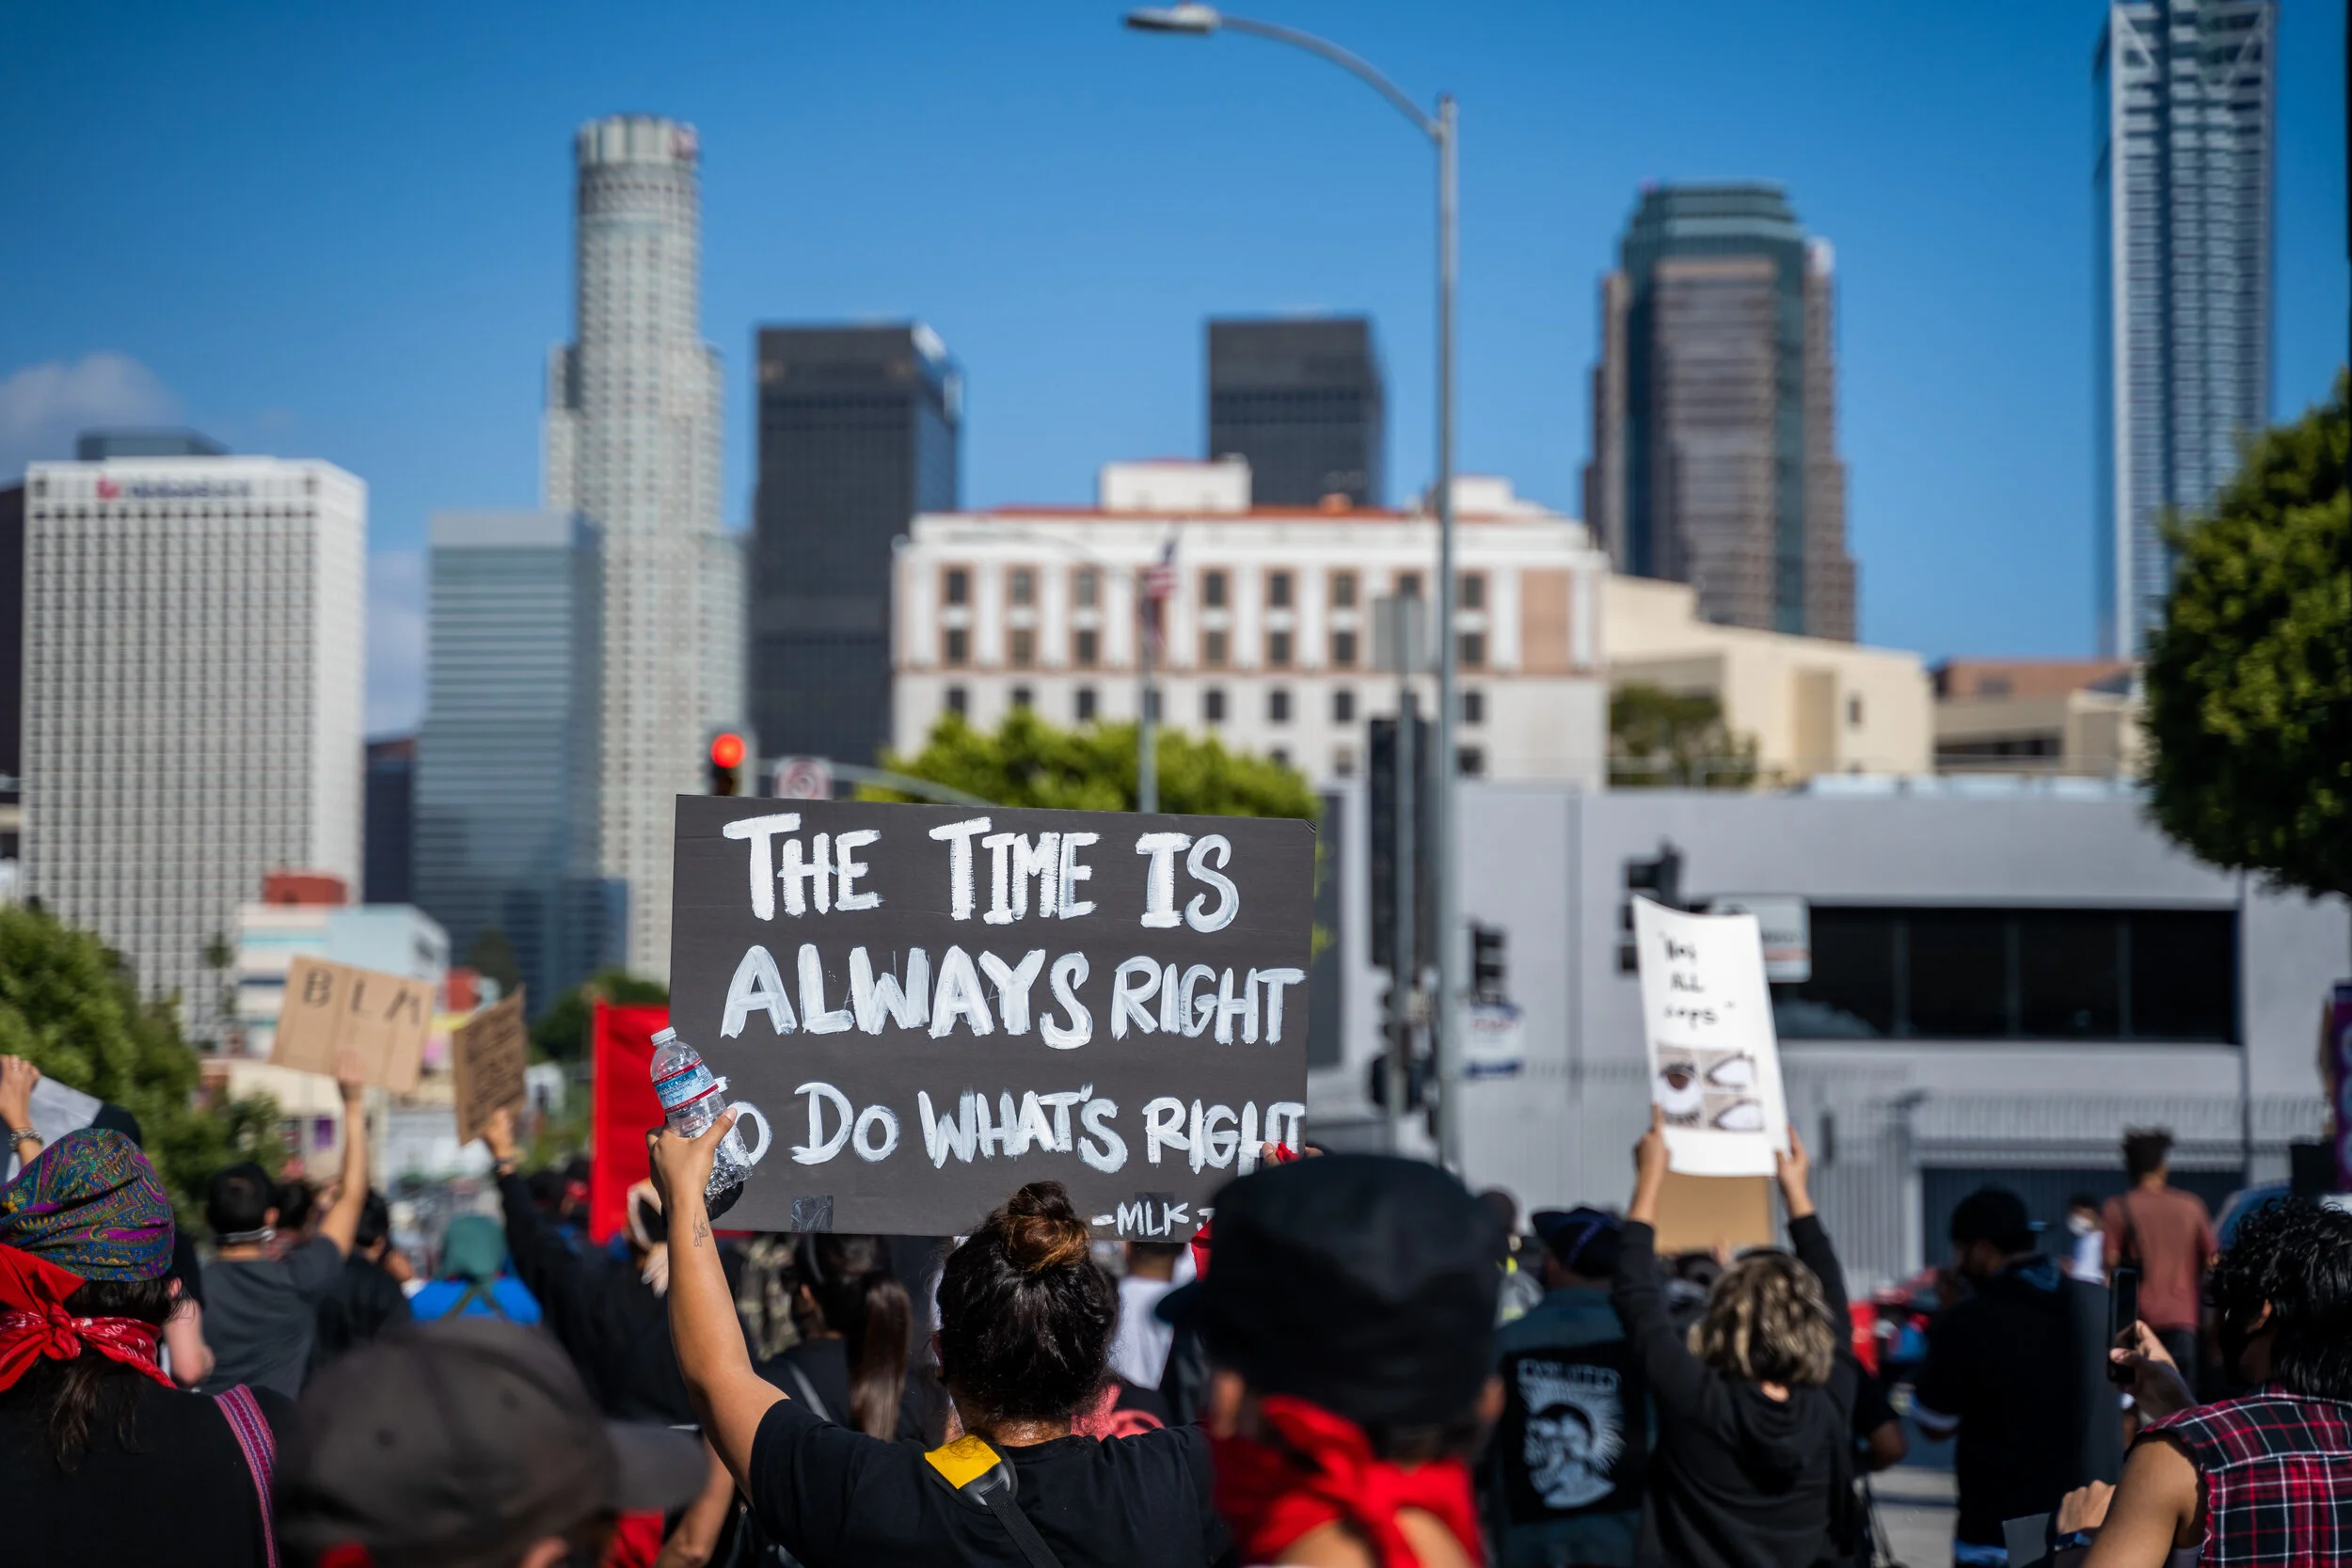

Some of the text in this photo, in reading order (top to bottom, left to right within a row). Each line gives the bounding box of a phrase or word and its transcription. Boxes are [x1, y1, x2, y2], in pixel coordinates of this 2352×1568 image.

[723, 813, 1240, 934] THE TIME IS
[302, 967, 421, 1025] BLM
[720, 943, 1307, 1051] ALWAYS RIGHT
[713, 1076, 772, 1166] O
[917, 1084, 1129, 1174] WHAT'S
[1141, 1096, 1306, 1178] RIGHT
